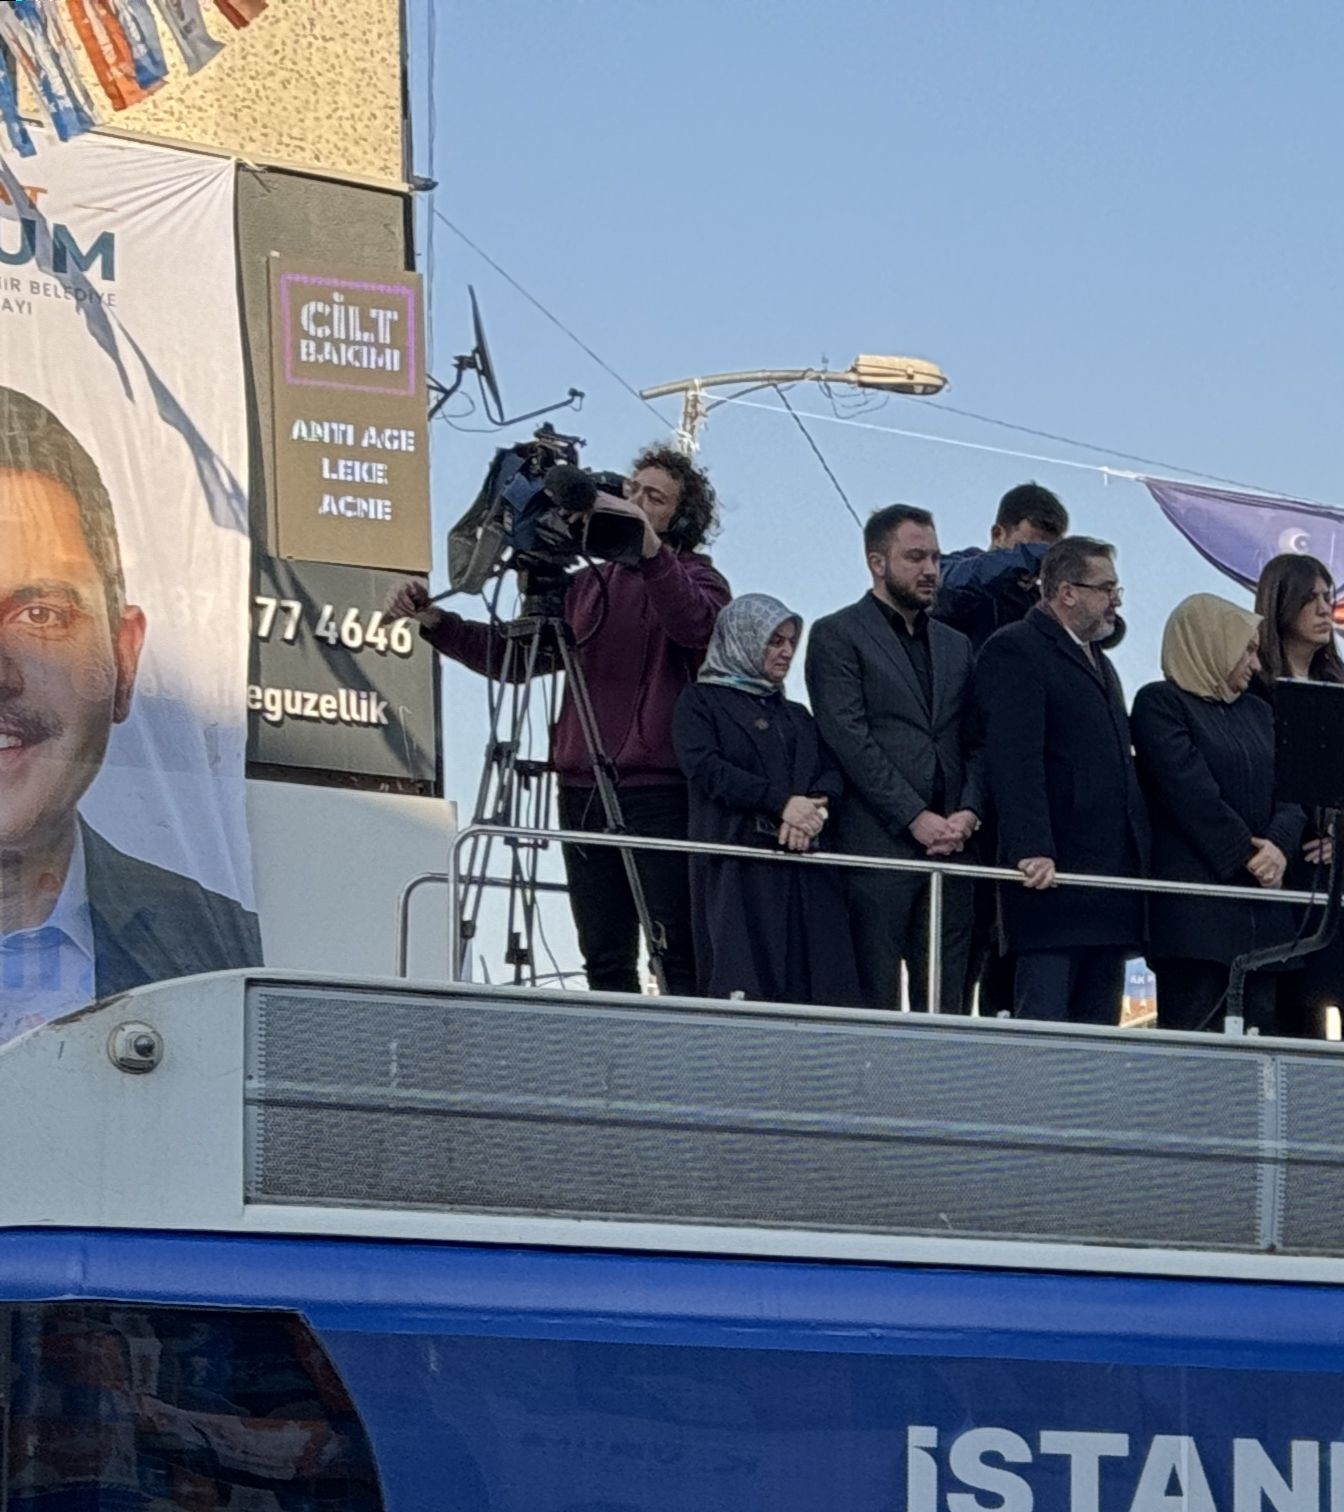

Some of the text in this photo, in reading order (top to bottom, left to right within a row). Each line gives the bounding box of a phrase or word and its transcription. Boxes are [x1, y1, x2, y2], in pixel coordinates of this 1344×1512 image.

[301, 292, 398, 344] CİLT
[292, 419, 415, 452] ANTI AGE
[321, 457, 388, 484] LEKE
[319, 493, 392, 520] ACNE
[314, 604, 414, 654] 4646
